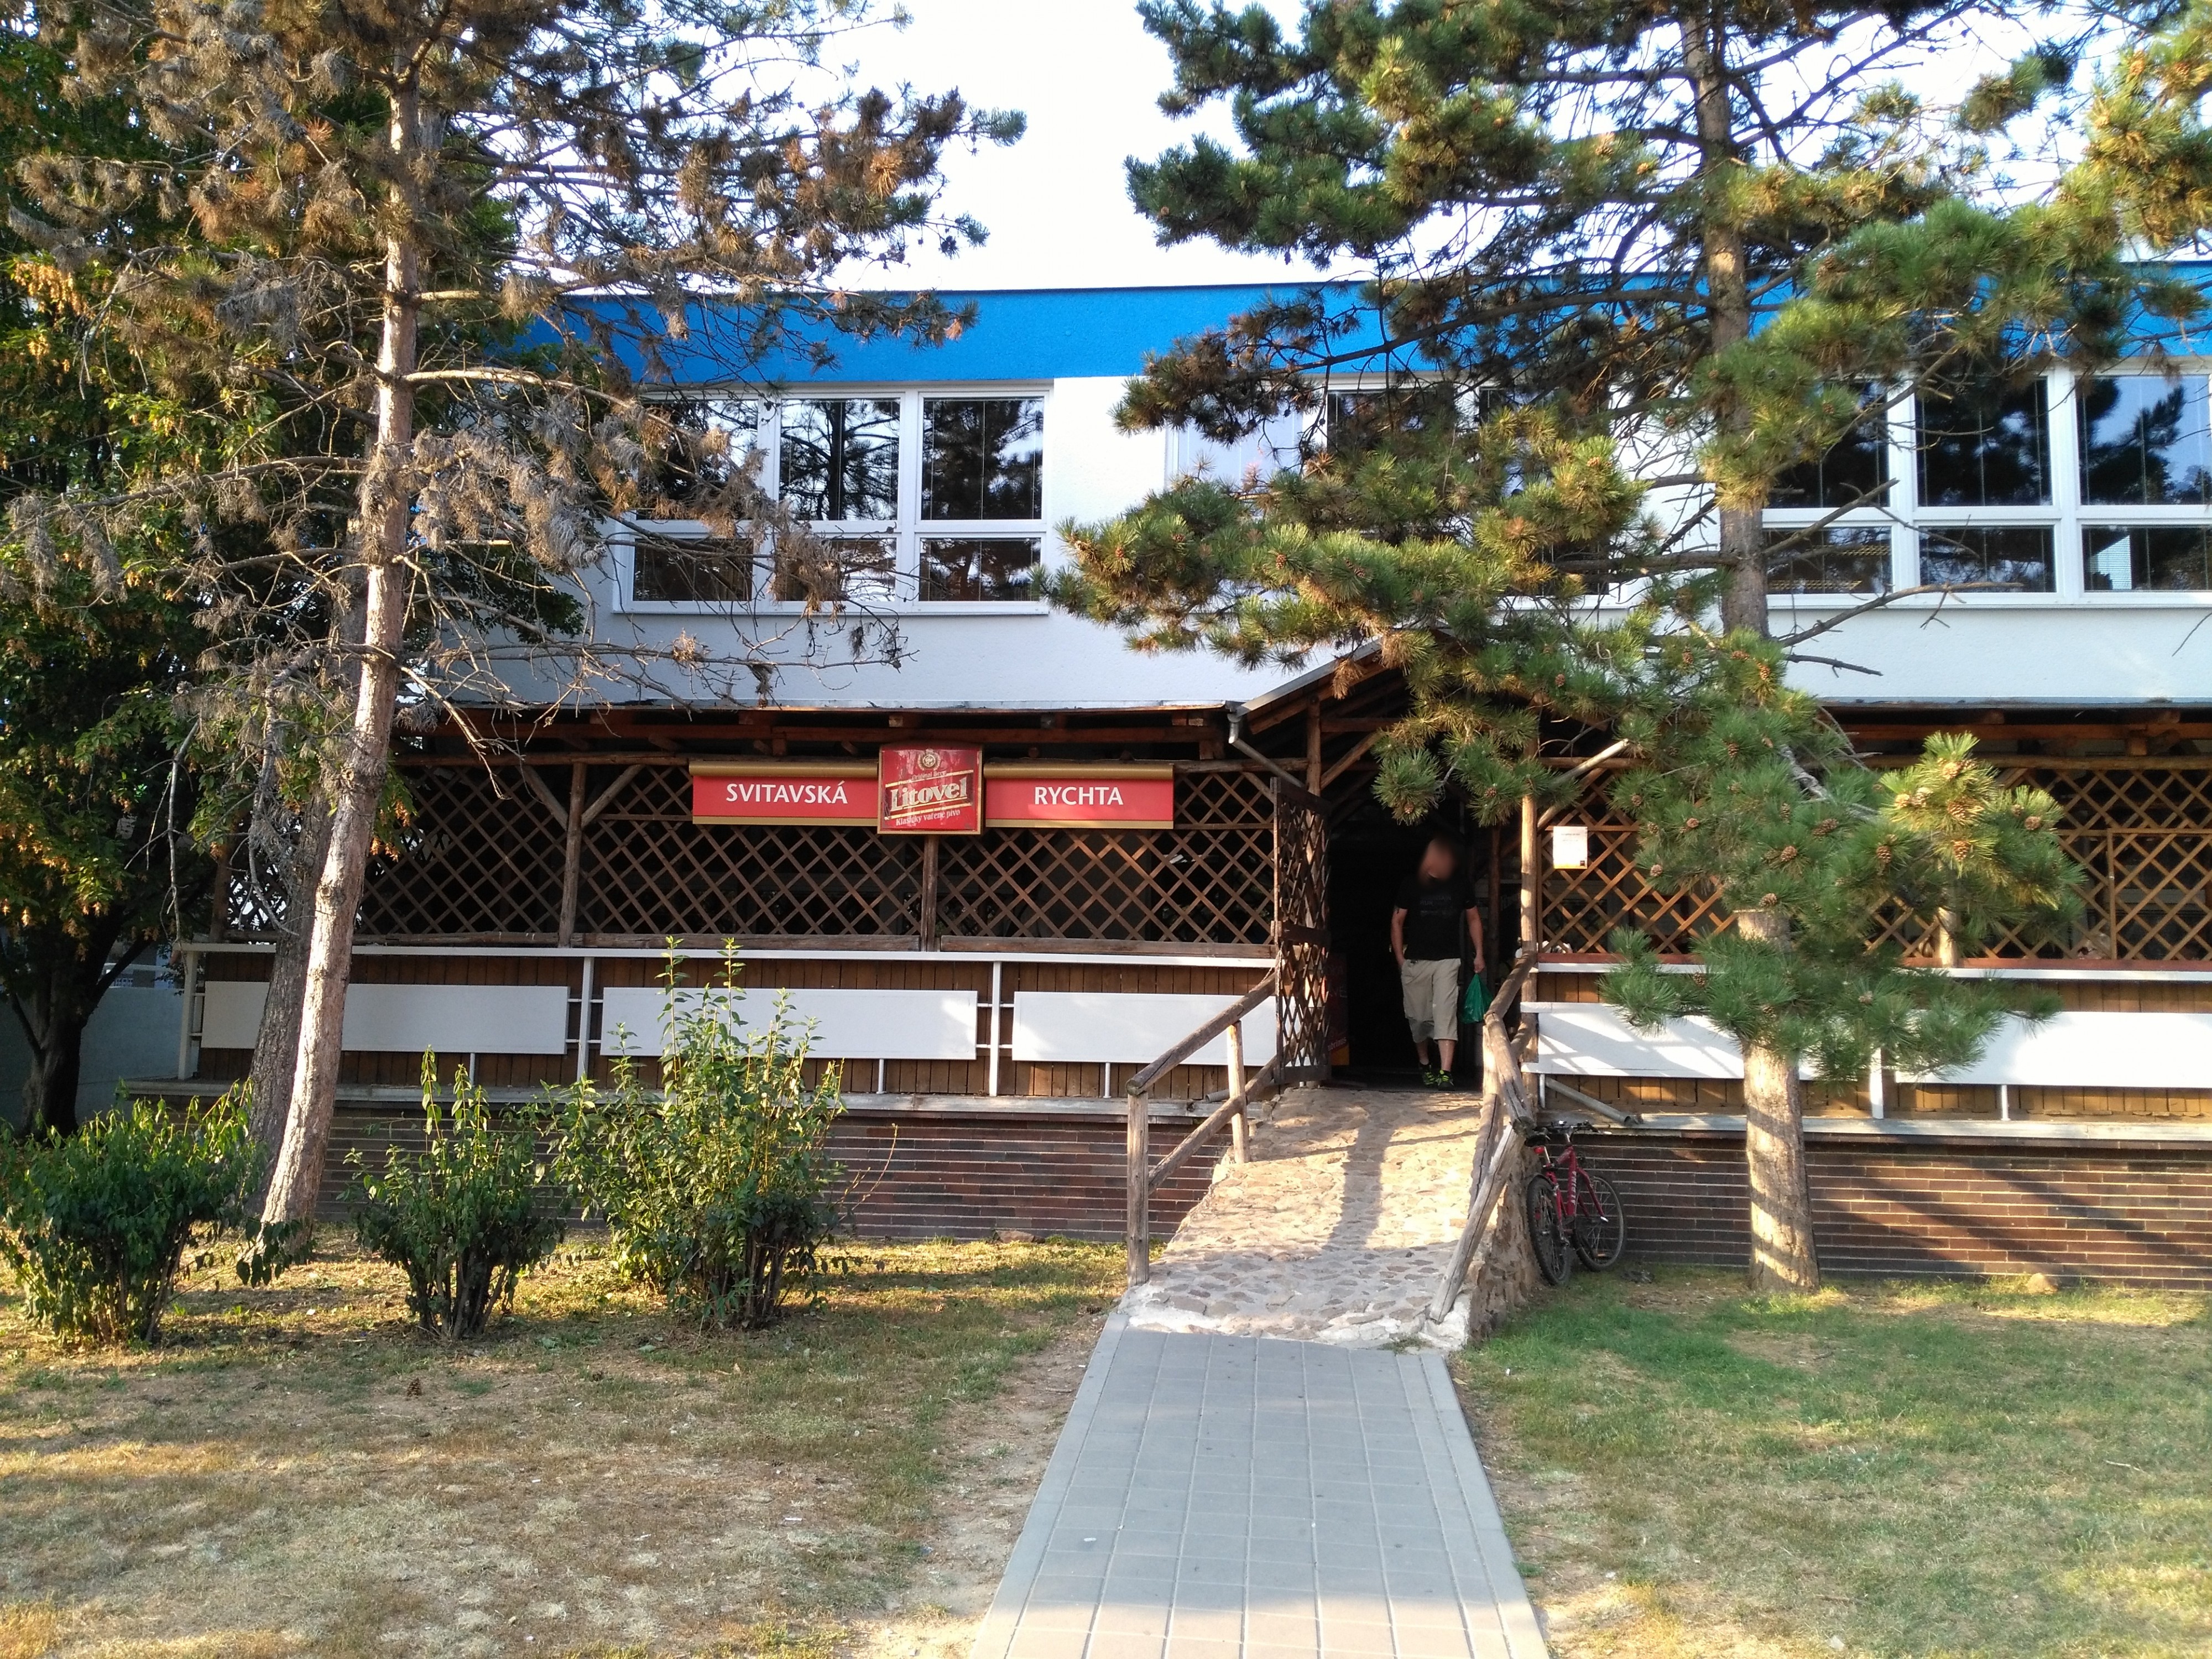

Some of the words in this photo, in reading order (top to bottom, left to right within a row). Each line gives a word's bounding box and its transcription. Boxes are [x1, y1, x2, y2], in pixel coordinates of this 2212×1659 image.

[726, 780, 848, 804] SVITAVSKÁ
[890, 776, 968, 812] Litovel
[1035, 786, 1124, 805] RYCHTA
[946, 809, 961, 818] pivo
